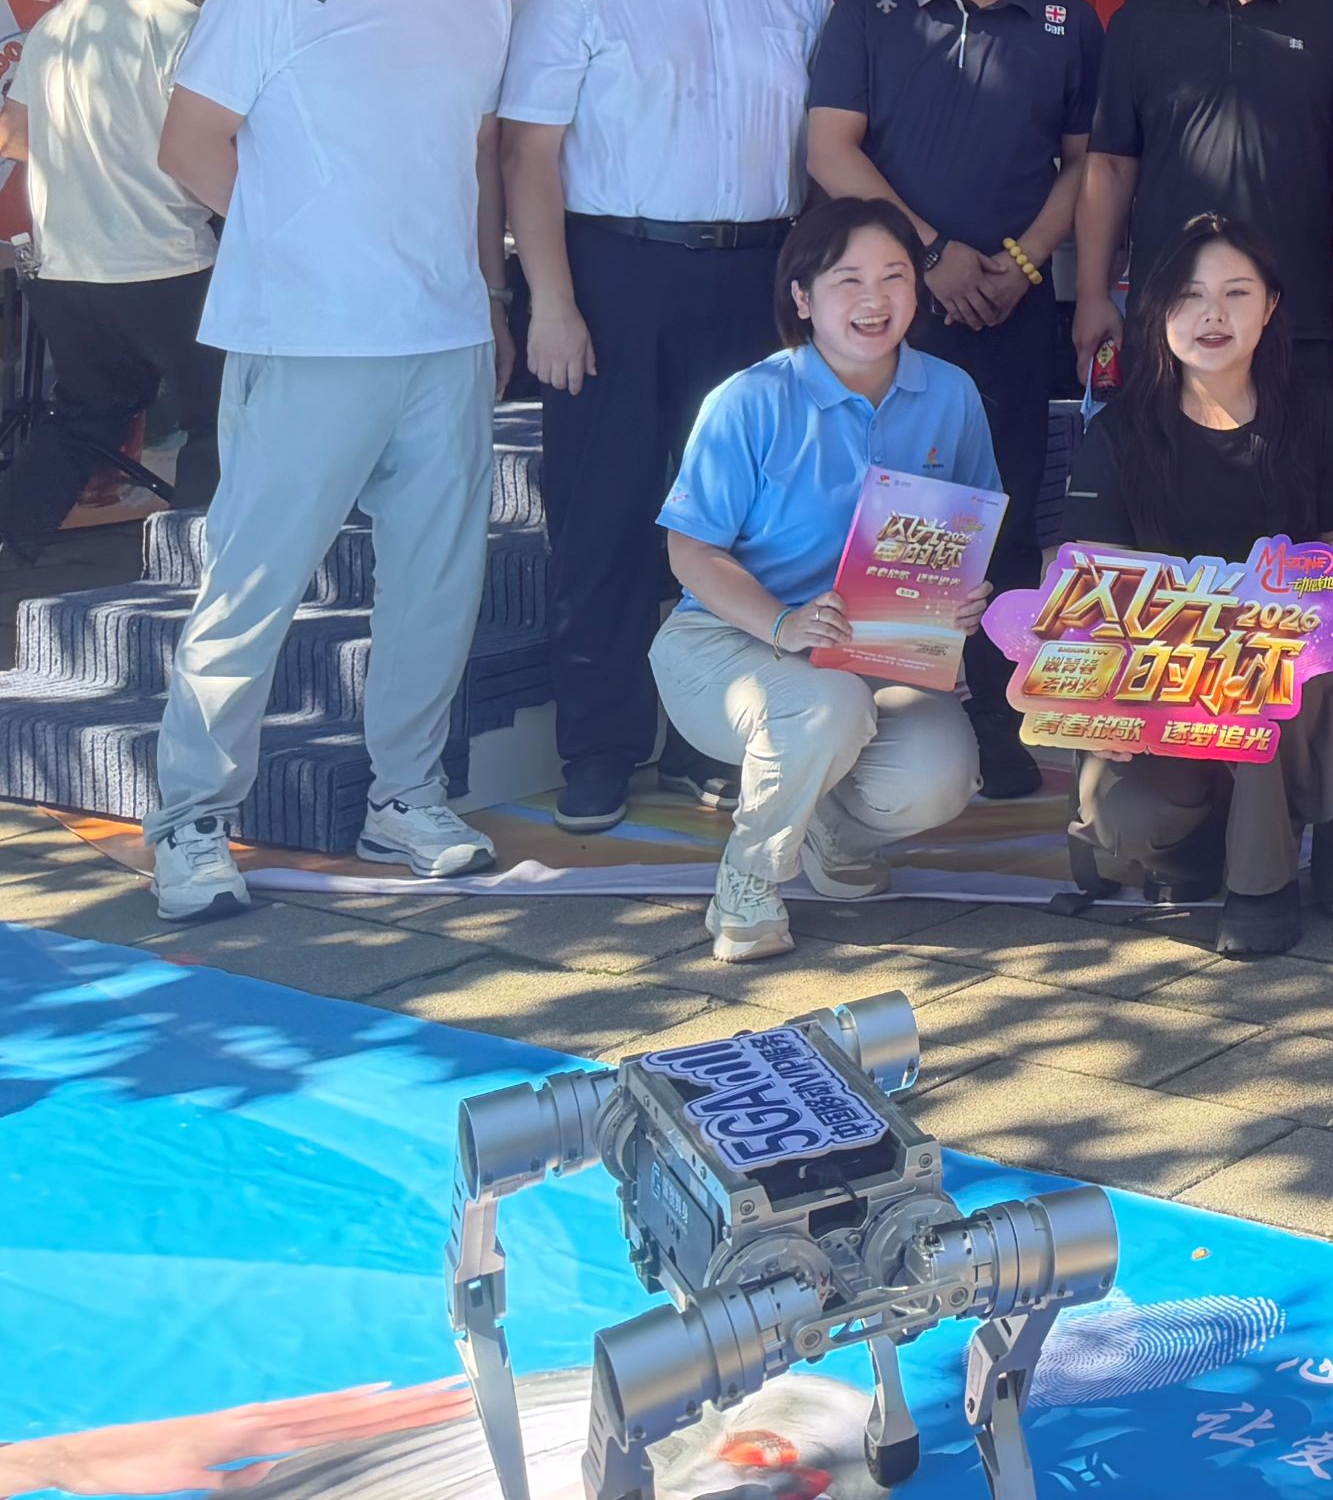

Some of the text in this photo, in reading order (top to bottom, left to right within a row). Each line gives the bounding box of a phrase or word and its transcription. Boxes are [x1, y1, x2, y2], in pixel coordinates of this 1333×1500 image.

[876, 510, 947, 545] 闪光
[1031, 550, 1246, 642] 闪光
[1237, 599, 1322, 632] 2026
[1039, 674, 1099, 695] 去闪光
[1114, 630, 1307, 716] 的你
[1031, 711, 1147, 742] 青春放歌
[1160, 721, 1272, 751] 逐梦追光
